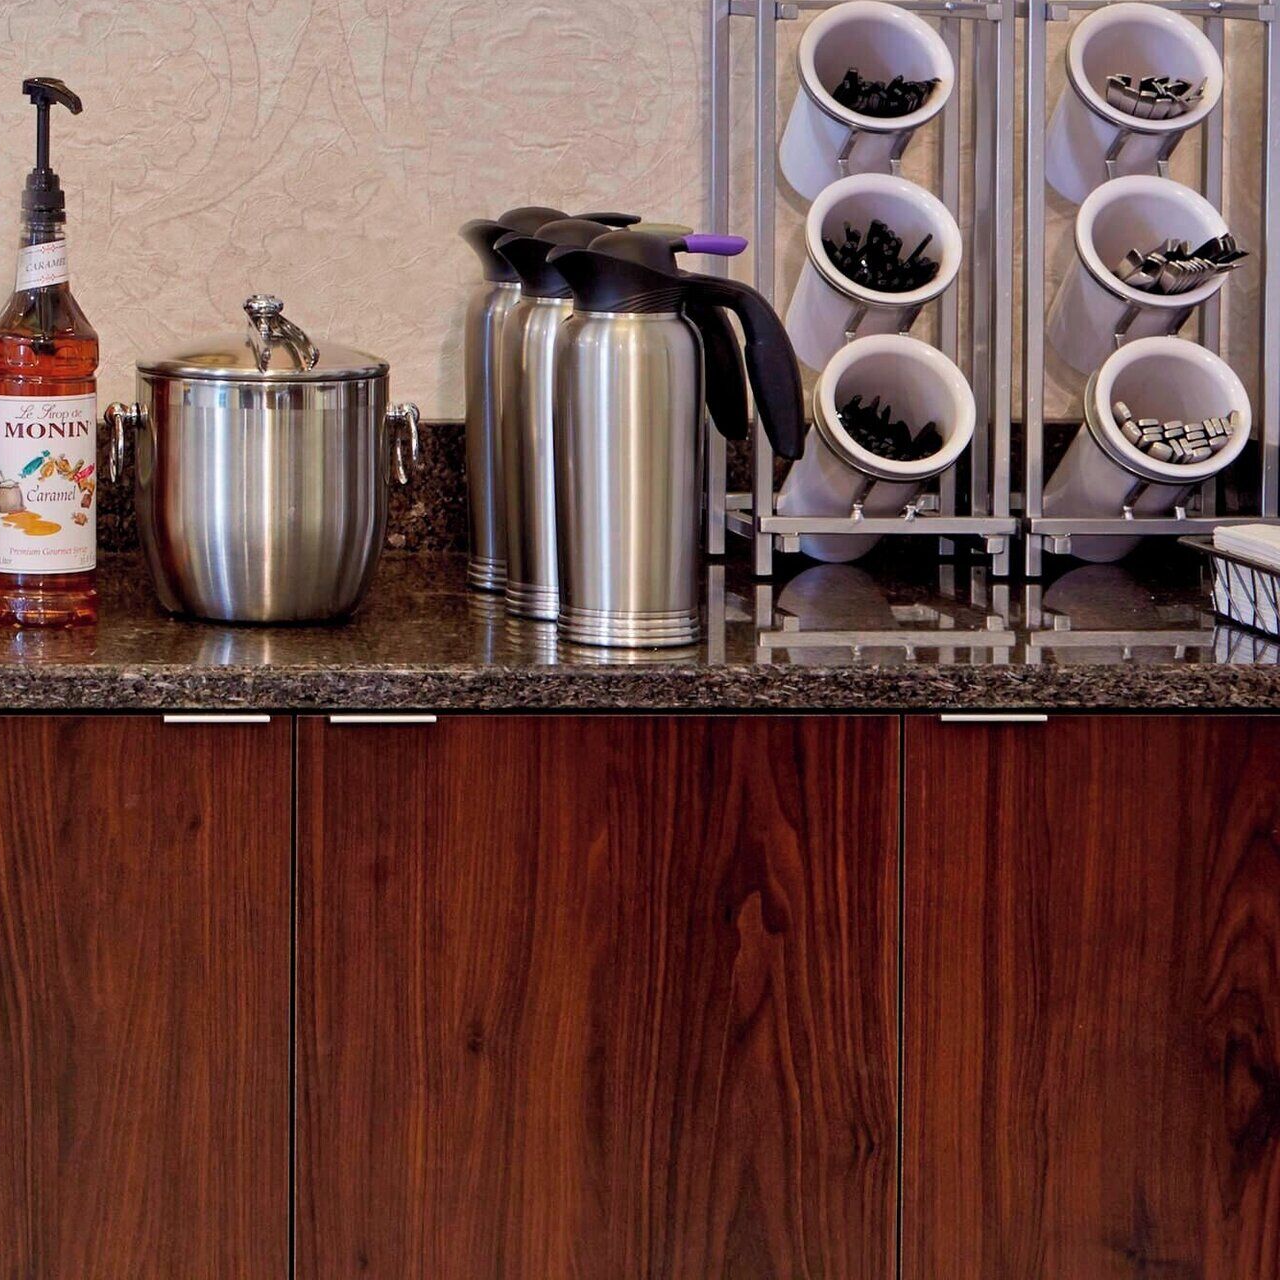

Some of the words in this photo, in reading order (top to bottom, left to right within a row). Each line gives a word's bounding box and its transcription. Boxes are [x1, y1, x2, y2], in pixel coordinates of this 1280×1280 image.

[15, 404, 35, 419] Le
[36, 403, 69, 423] Sirop
[71, 409, 82, 418] de
[4, 420, 90, 439] MONIN
[26, 484, 76, 502] Caramel
